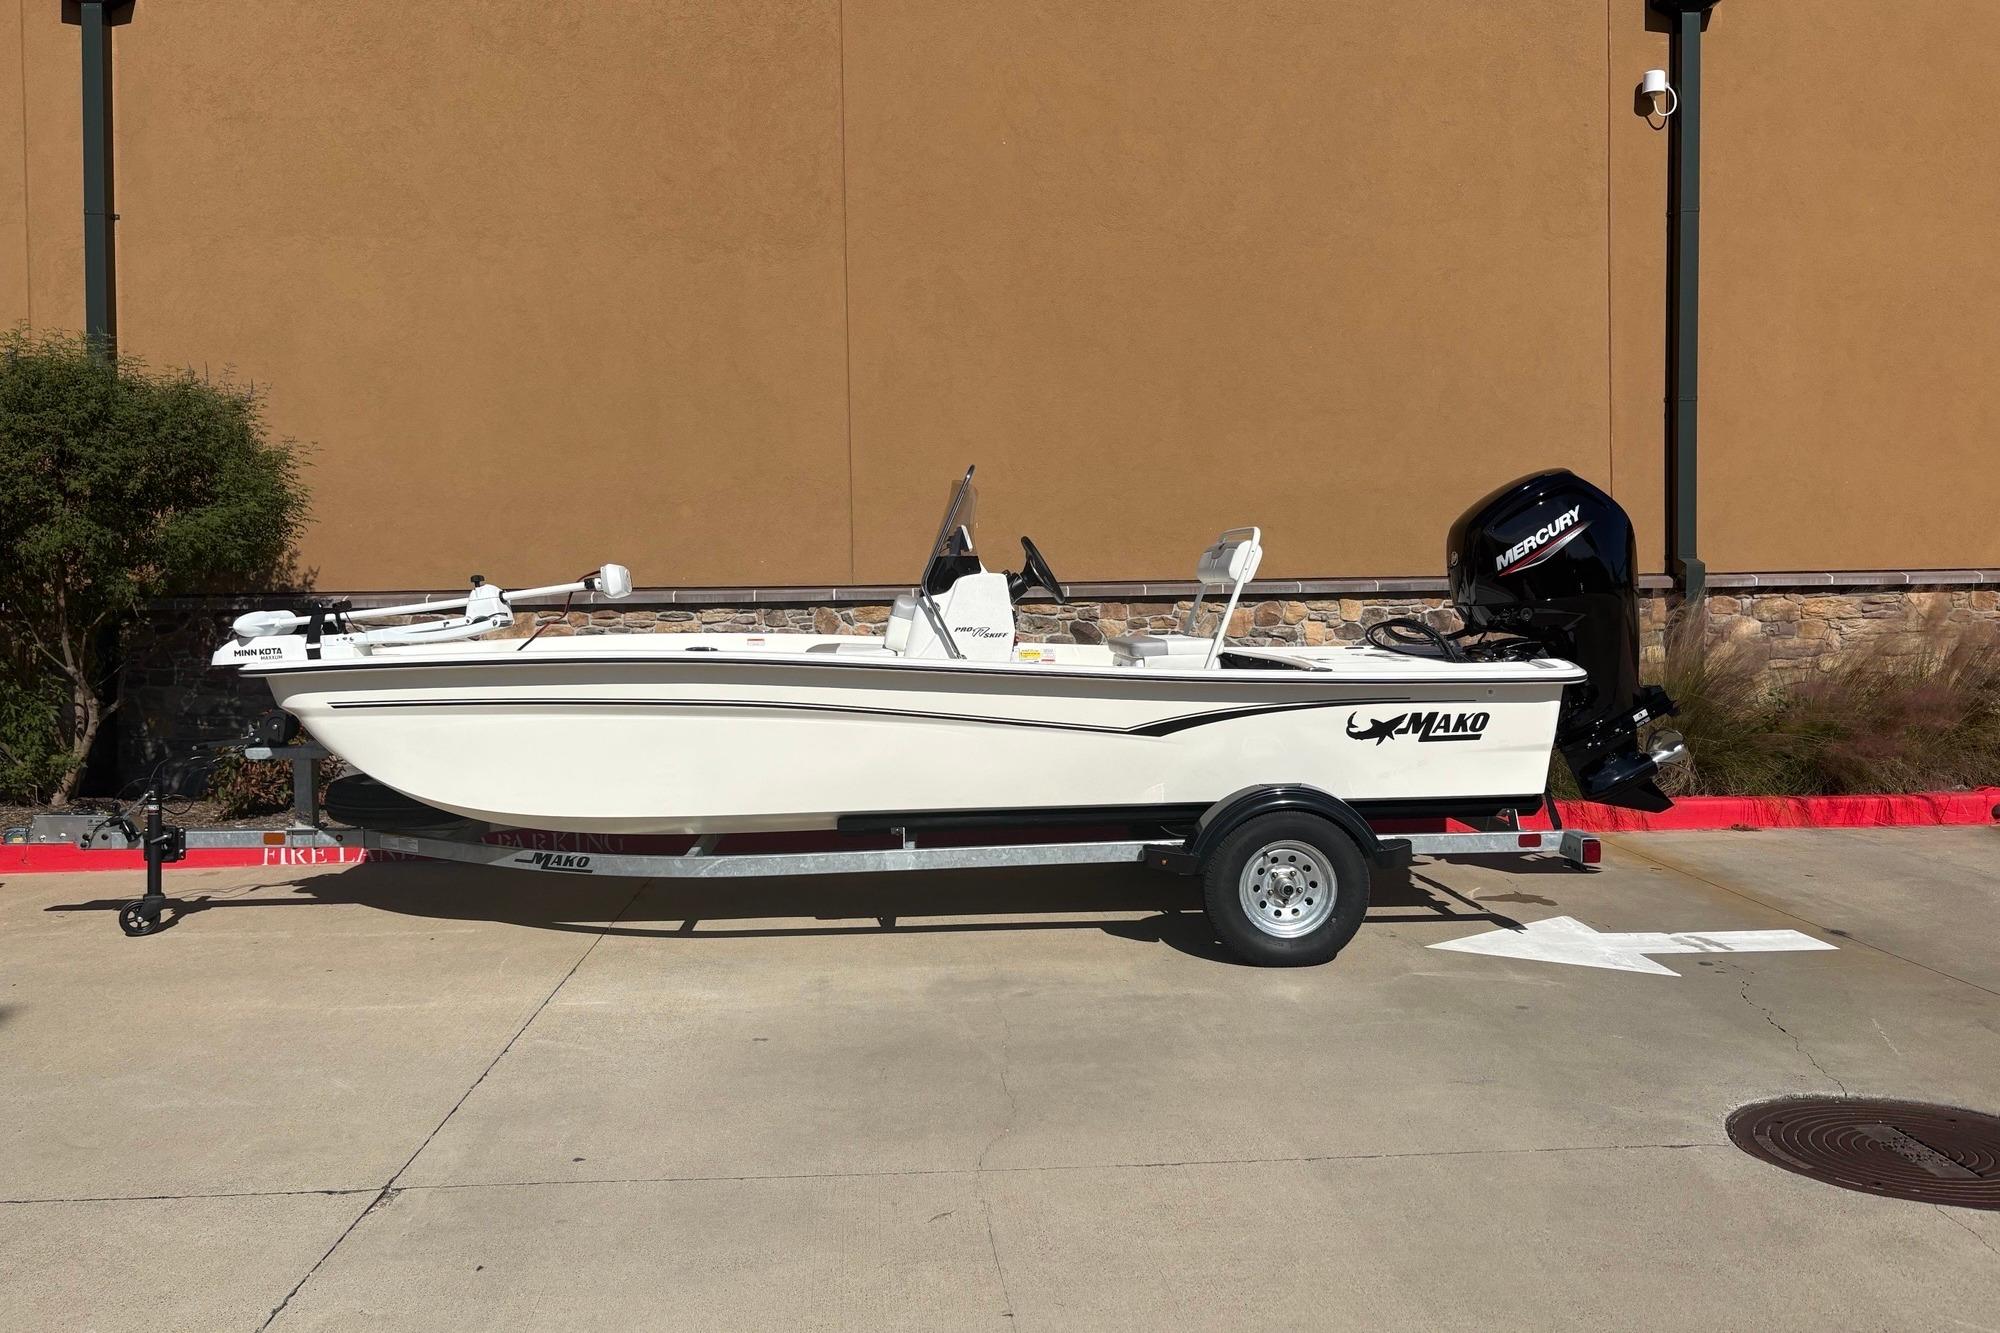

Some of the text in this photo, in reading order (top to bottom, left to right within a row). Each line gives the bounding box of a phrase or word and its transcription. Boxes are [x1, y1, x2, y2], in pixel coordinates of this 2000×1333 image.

[1496, 504, 1580, 571] MERCURY
[234, 647, 283, 657] MINN KOTA
[1394, 711, 1490, 742] MAKO
[262, 847, 327, 866] FIRE
[514, 852, 593, 874] MAKO
